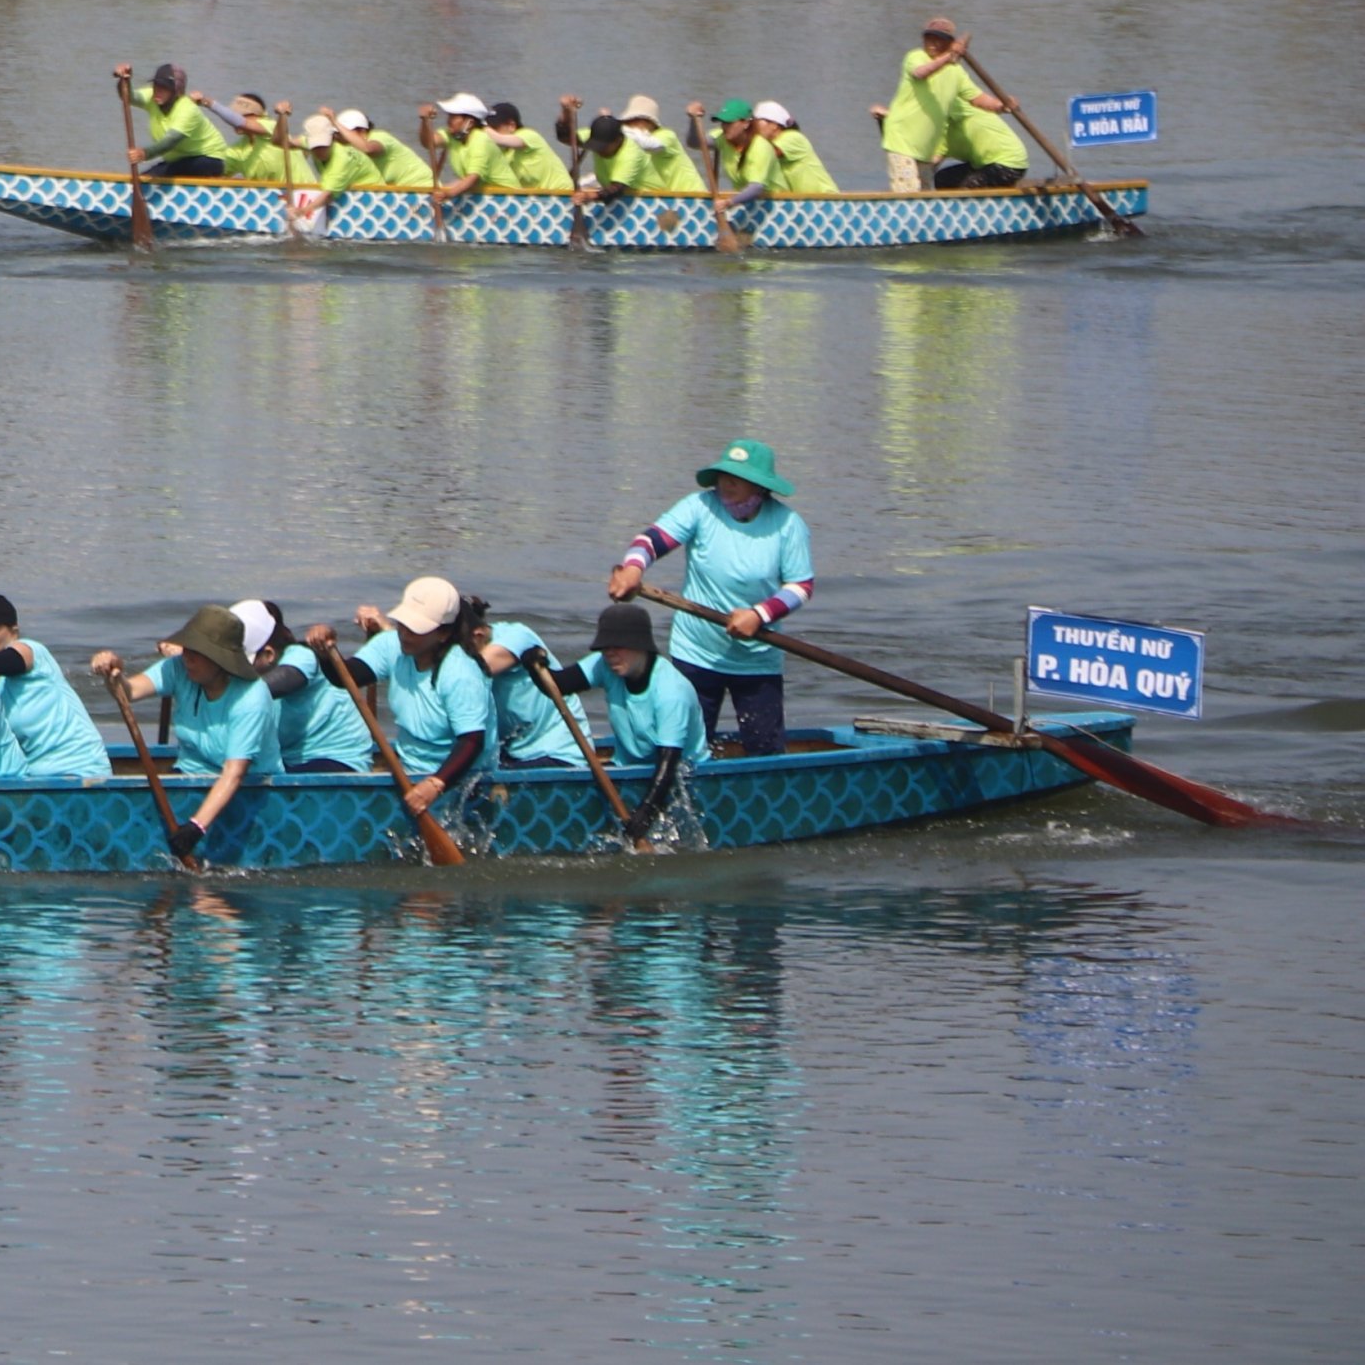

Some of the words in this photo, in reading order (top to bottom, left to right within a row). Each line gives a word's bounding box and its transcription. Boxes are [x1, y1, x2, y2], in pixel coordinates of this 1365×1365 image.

[1074, 121, 1087, 138] P.
[1088, 116, 1120, 136] HÒA
[1121, 112, 1149, 133] HẢI
[1052, 625, 1137, 654] THUYỀN
[1141, 637, 1174, 660] NỮ
[1037, 653, 1061, 681] P.
[1069, 655, 1129, 691] HÒA
[1136, 671, 1192, 701] QUÝ
